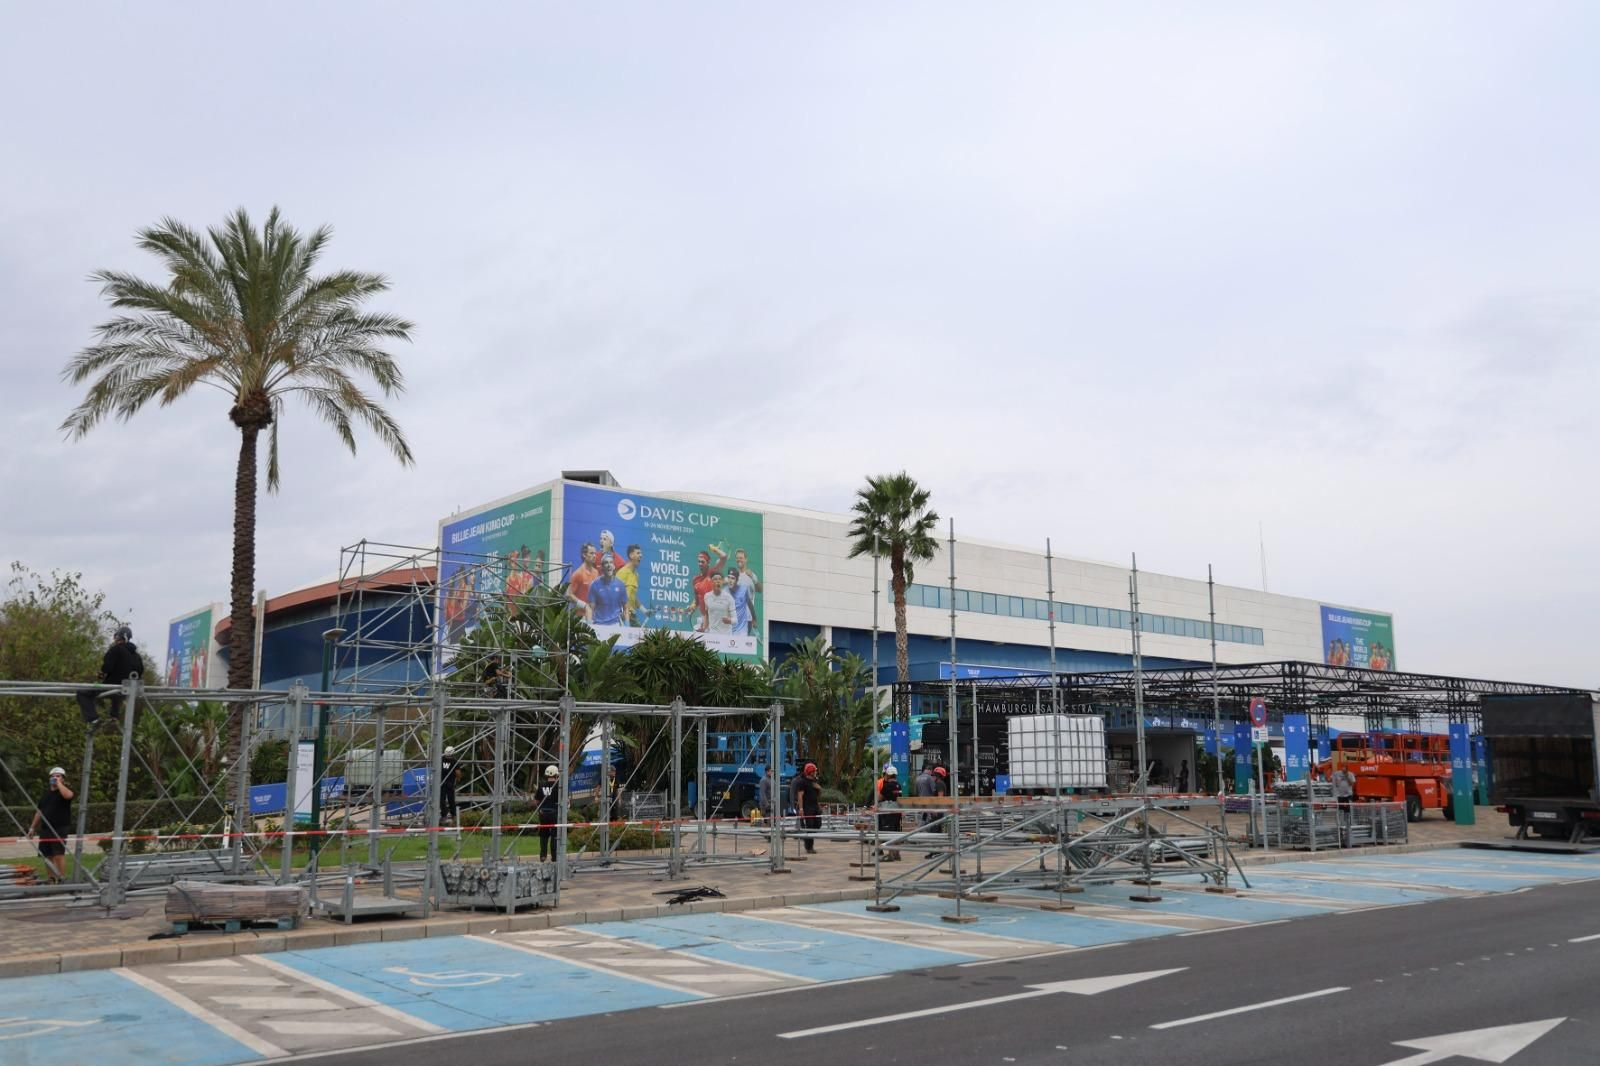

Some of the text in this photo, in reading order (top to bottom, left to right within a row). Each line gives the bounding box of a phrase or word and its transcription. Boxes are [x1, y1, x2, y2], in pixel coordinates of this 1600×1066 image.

[640, 505, 719, 528] DAVIS CUP
[451, 528, 471, 544] BILLIE
[470, 521, 486, 538] JEAN
[485, 518, 501, 533] KING
[501, 513, 515, 528] CUP
[659, 550, 681, 562] THE
[650, 561, 689, 577] WORLD
[650, 575, 689, 590] CUP OF
[650, 588, 689, 603] TENNIS
[978, 703, 1052, 714] HAMBURGUSA
